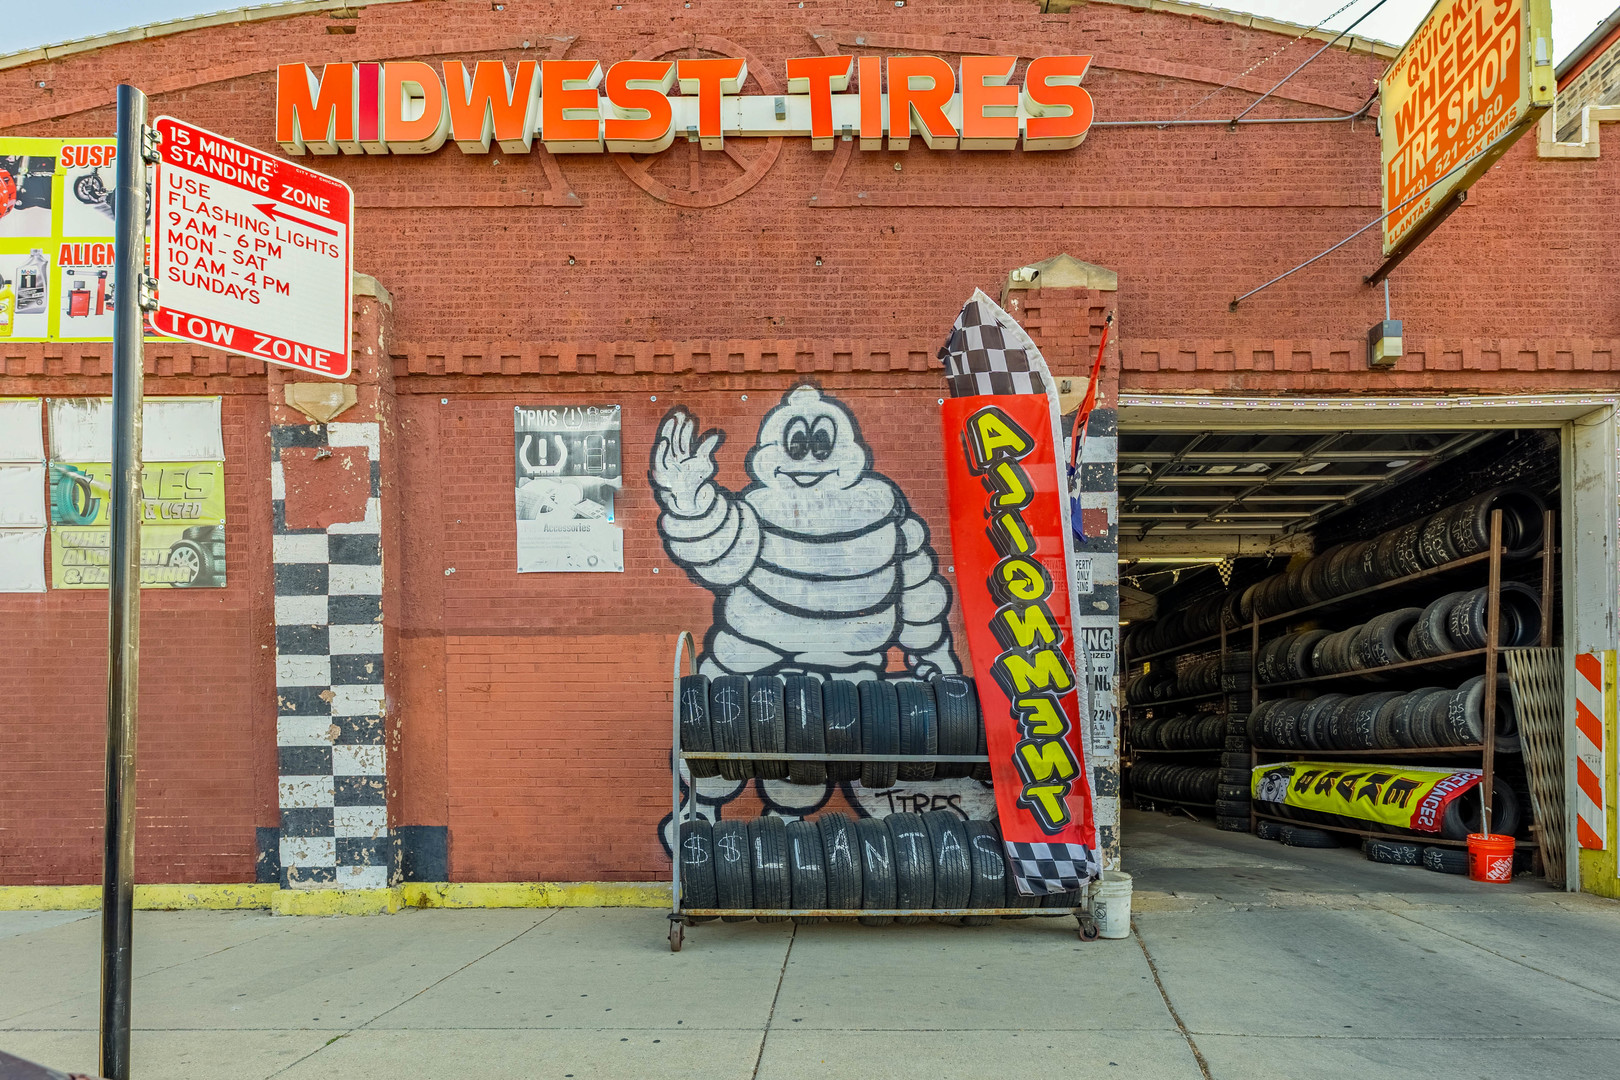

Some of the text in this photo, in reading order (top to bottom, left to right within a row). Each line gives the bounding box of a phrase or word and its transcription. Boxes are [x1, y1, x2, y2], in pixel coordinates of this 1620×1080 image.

[1386, 16, 1435, 86] TIRE SHOP
[1408, 0, 1479, 88] QUICK
[1394, 0, 1513, 147] WHEELS
[277, 55, 1093, 154] MIDWEST TIRES
[1392, 25, 1516, 197] TIRE SHOP
[61, 145, 117, 168] SUSP
[169, 126, 191, 146] 15
[200, 137, 274, 177] MINUTE
[1389, 197, 1431, 245] LLANTAS
[1486, 107, 1517, 146] RIMS
[1399, 94, 1503, 216] (773) 521-9360
[169, 173, 211, 200] USE
[170, 146, 331, 214] STANDING ZONE
[168, 229, 213, 256] MON
[233, 250, 268, 271] SAT
[169, 191, 339, 259] FLASHING LIGHTS
[169, 211, 181, 226] 9
[185, 217, 217, 239] AM
[237, 234, 249, 248] 6
[255, 238, 282, 259] PM
[168, 248, 189, 266] 10
[194, 257, 225, 278] AM
[243, 272, 257, 286] 4
[263, 276, 290, 297] PM
[168, 266, 260, 304] SUNDAYS
[166, 311, 332, 371] TOW ZONE
[518, 409, 558, 427] TPMS
[160, 502, 202, 520] USED
[543, 523, 591, 533] Accessories
[1077, 570, 1089, 580] ONLY
